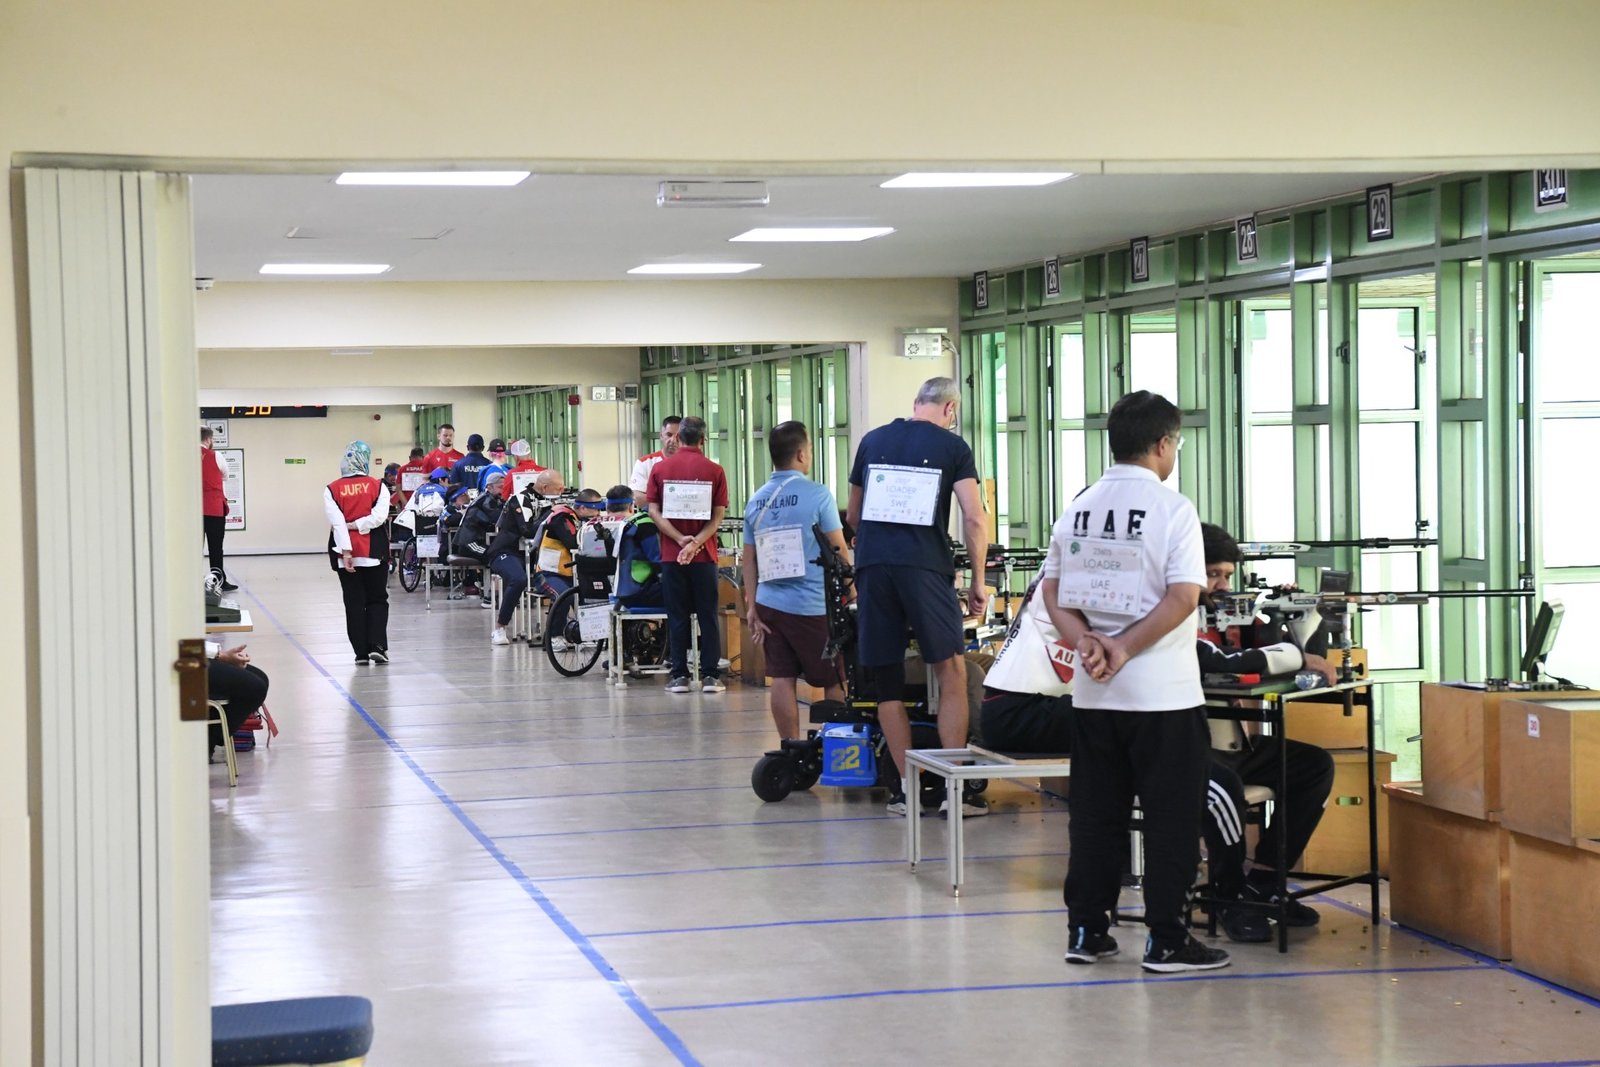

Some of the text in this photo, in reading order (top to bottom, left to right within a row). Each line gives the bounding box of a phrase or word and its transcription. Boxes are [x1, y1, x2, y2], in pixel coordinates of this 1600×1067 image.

[1372, 197, 1387, 231] 29
[1134, 246, 1144, 275] 27
[340, 482, 370, 496] JURY
[886, 485, 918, 494] LOADER
[890, 499, 908, 509] SWE
[1073, 508, 1147, 540] UAE
[1083, 558, 1122, 571] LOADER
[1090, 579, 1111, 591] UAE
[831, 745, 860, 772] 22
